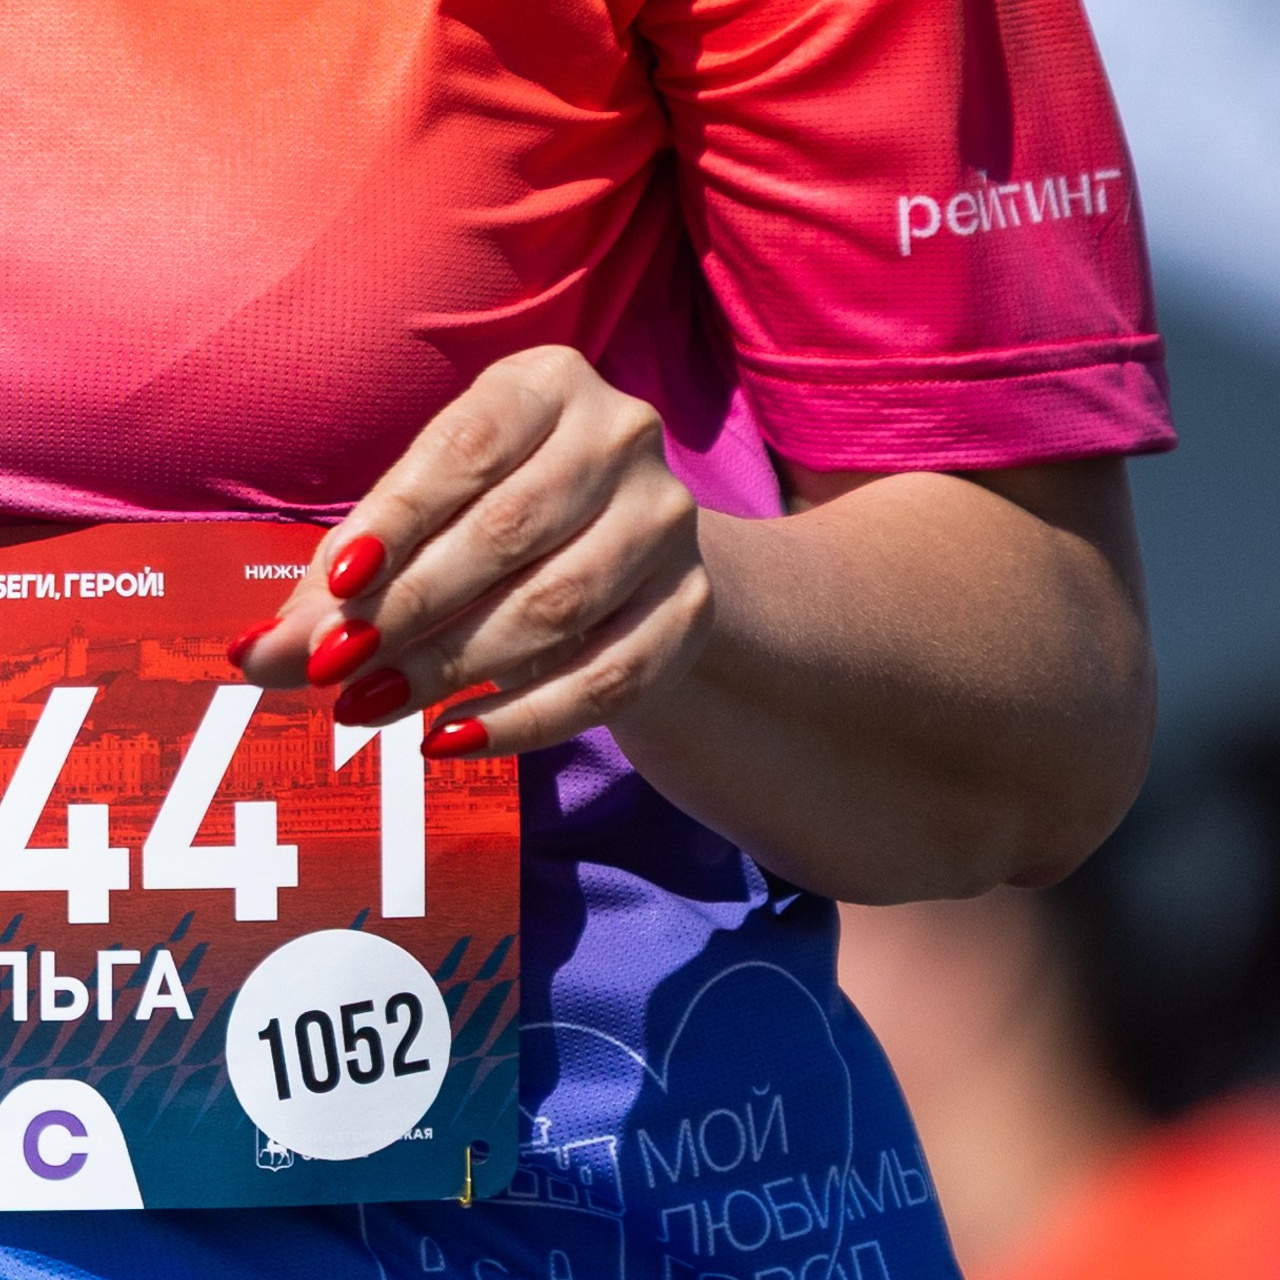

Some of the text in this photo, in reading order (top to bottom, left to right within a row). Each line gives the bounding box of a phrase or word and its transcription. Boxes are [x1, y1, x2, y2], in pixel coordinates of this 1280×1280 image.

[64, 566, 165, 598] ГЕРОЙ!
[244, 564, 313, 580] НИЖН
[257, 991, 431, 1101] 1052
[637, 1081, 789, 1190] МОЙ
